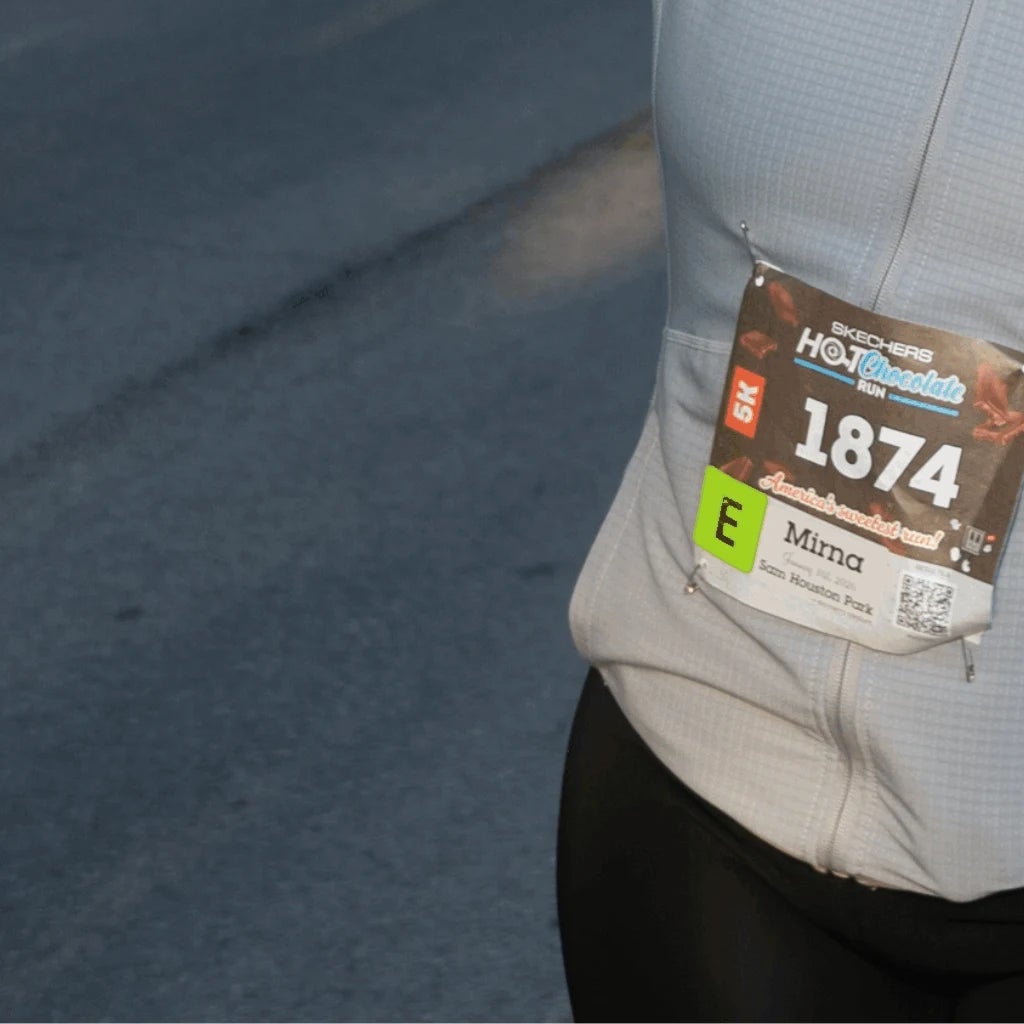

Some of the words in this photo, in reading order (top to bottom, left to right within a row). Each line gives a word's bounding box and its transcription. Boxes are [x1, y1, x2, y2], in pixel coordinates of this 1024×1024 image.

[796, 327, 866, 373] HOT
[858, 349, 967, 404] Chocolate
[831, 321, 934, 364] SKECHERS
[732, 380, 759, 424] 5K
[857, 379, 887, 399] RUN
[795, 397, 962, 509] 1874
[715, 496, 743, 547] E
[758, 472, 836, 515] America's
[835, 504, 900, 539] sweetest
[898, 528, 945, 551] run!
[784, 520, 864, 573] Mirna
[759, 559, 786, 580] Sam
[789, 572, 841, 603] Houston
[844, 595, 874, 616] Park
